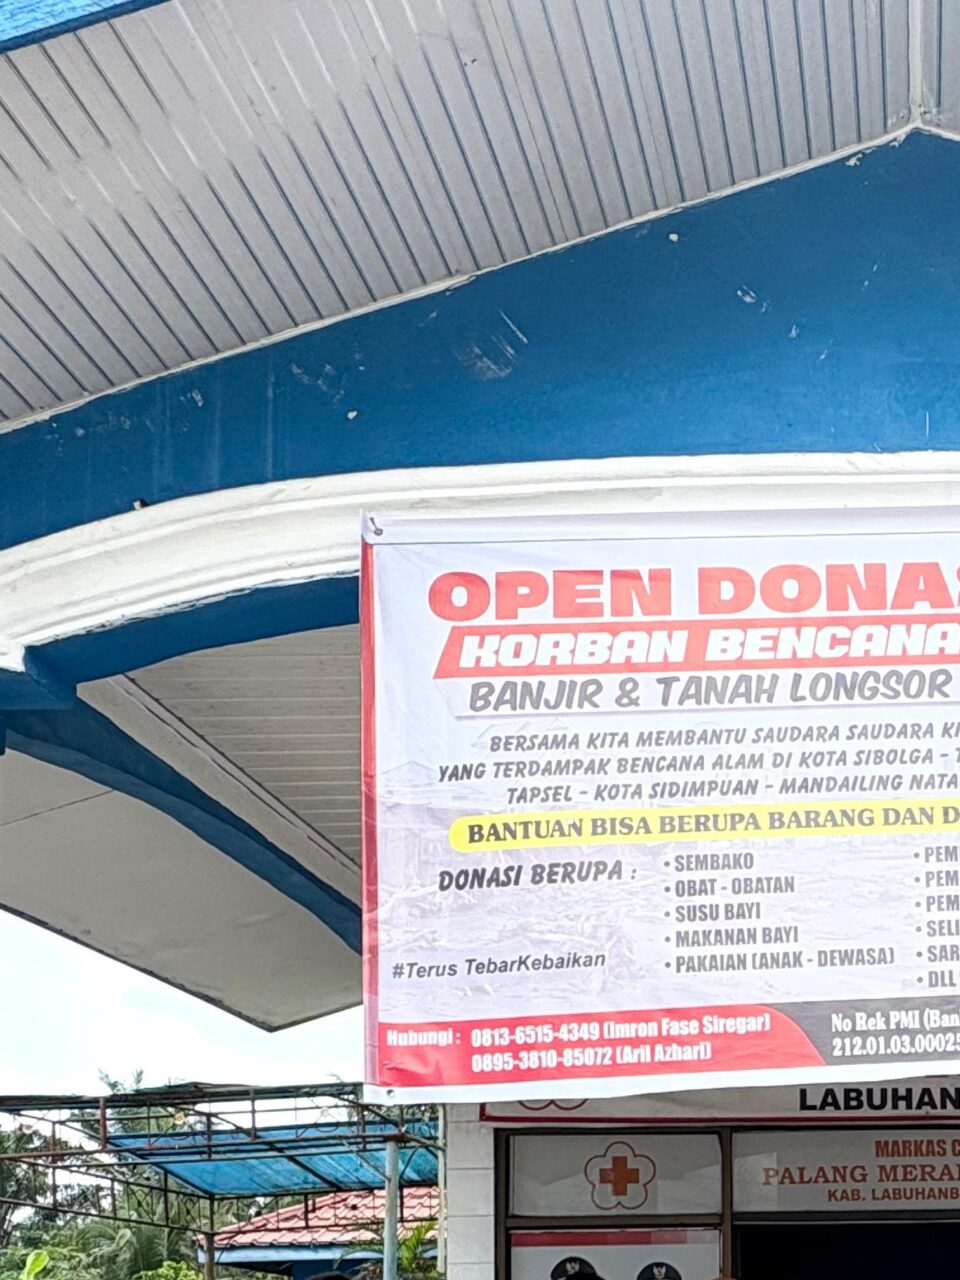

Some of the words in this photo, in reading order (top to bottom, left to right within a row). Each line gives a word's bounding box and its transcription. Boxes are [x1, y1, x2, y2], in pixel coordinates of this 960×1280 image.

[428, 567, 672, 622] OPEN
[459, 630, 688, 668] KORBAN
[468, 678, 602, 712] BANJIR
[615, 677, 640, 708] &
[657, 672, 777, 706] TANAH
[791, 668, 953, 703] LONGSOR
[490, 732, 580, 753] BERSAMA
[586, 731, 629, 750] KITA
[635, 728, 747, 748] MEMBANTU
[751, 725, 840, 745] SAUDARA
[845, 722, 935, 742] SAUDARA
[438, 763, 486, 783] YANG
[492, 758, 609, 779] TERDAMPAK
[615, 756, 705, 775] BENCANA
[710, 753, 764, 771] ALAM
[771, 751, 793, 770] DI
[798, 749, 848, 768] KOTA
[853, 746, 934, 766] SIBOLGA
[506, 785, 573, 803] TAPSEL
[594, 782, 645, 800] KOTA
[650, 779, 760, 798] SIDIMPUAN
[777, 775, 904, 795] MANDAILING
[467, 818, 584, 844] BANTUAN
[590, 815, 652, 836] BISA
[658, 811, 761, 834] BERUPA
[768, 807, 875, 829] BARANG
[882, 806, 935, 826] DAN
[438, 864, 523, 891] DONASI
[530, 859, 623, 887] BERUPA
[674, 852, 754, 872] SEMBAKO
[675, 878, 717, 897] OBAT
[731, 876, 794, 895] OBATAN
[675, 904, 719, 922] SUSU
[724, 902, 761, 920] BAYI
[675, 928, 757, 948] MAKANAN
[762, 926, 799, 945] BAYI
[392, 959, 458, 980] #Terus
[465, 951, 606, 976] TebarKebaikan
[675, 954, 747, 974] PAKAIAN
[927, 970, 957, 988] DLL
[471, 1021, 600, 1048] 0813-6515-4349
[661, 1018, 698, 1038] Fase
[831, 1012, 853, 1032] No
[856, 1010, 885, 1031] Rek
[888, 1009, 920, 1030] PMI
[472, 1046, 612, 1073] 0895-3810-85072
[875, 1139, 947, 1158] MARKAS
[763, 1165, 868, 1186] PALANG
[827, 1188, 866, 1202] KAB.
